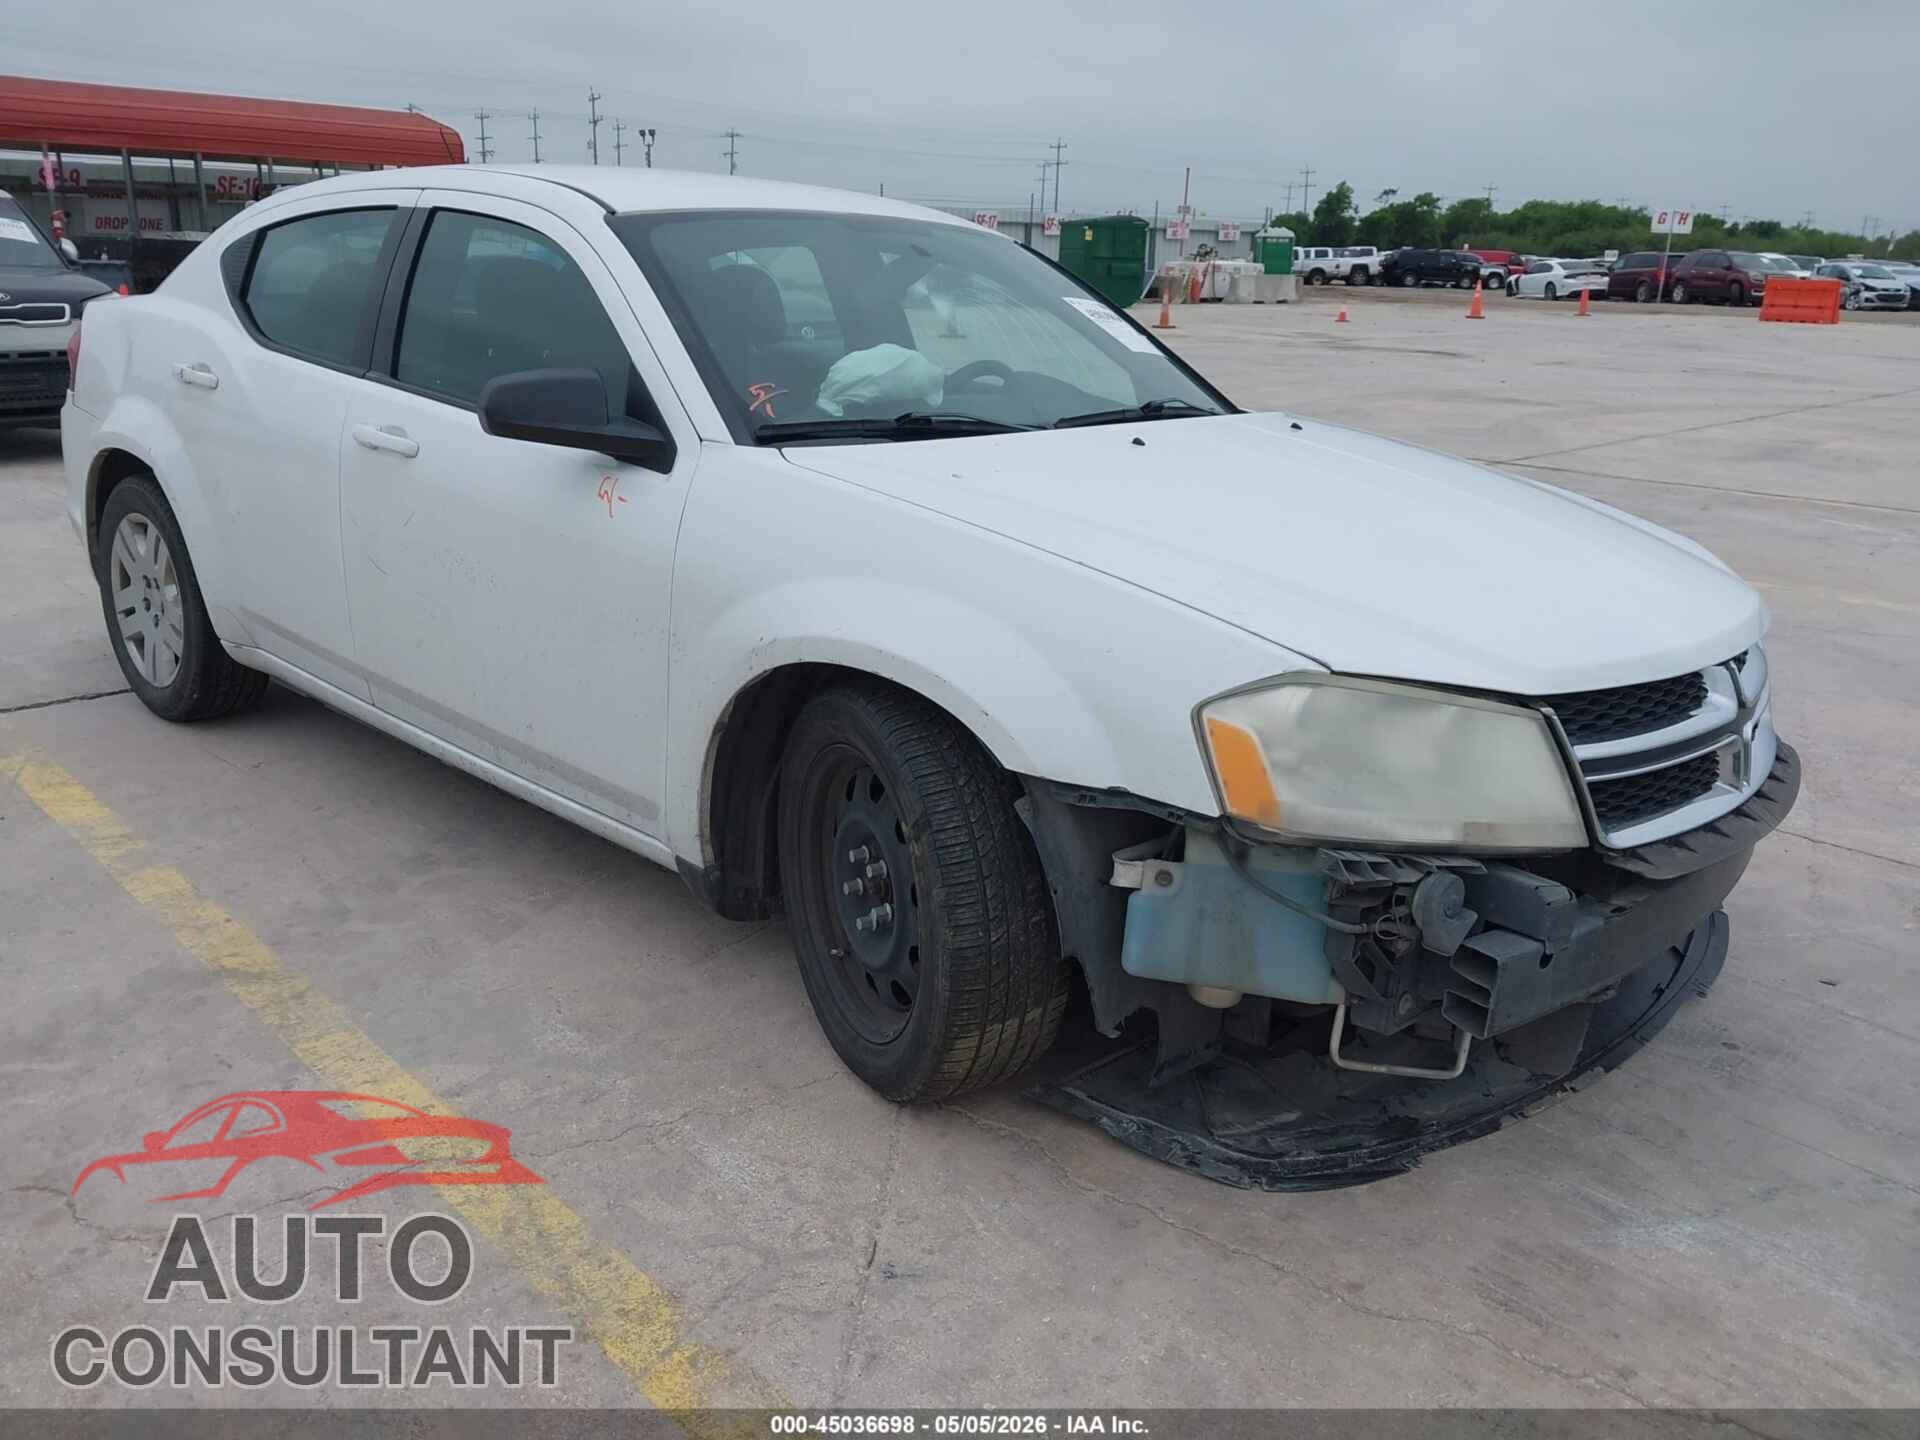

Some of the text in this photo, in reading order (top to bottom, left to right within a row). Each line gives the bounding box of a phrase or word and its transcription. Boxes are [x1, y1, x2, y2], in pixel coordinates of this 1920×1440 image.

[95, 216, 164, 231] DROP ONE
[1657, 211, 1689, 225] G H
